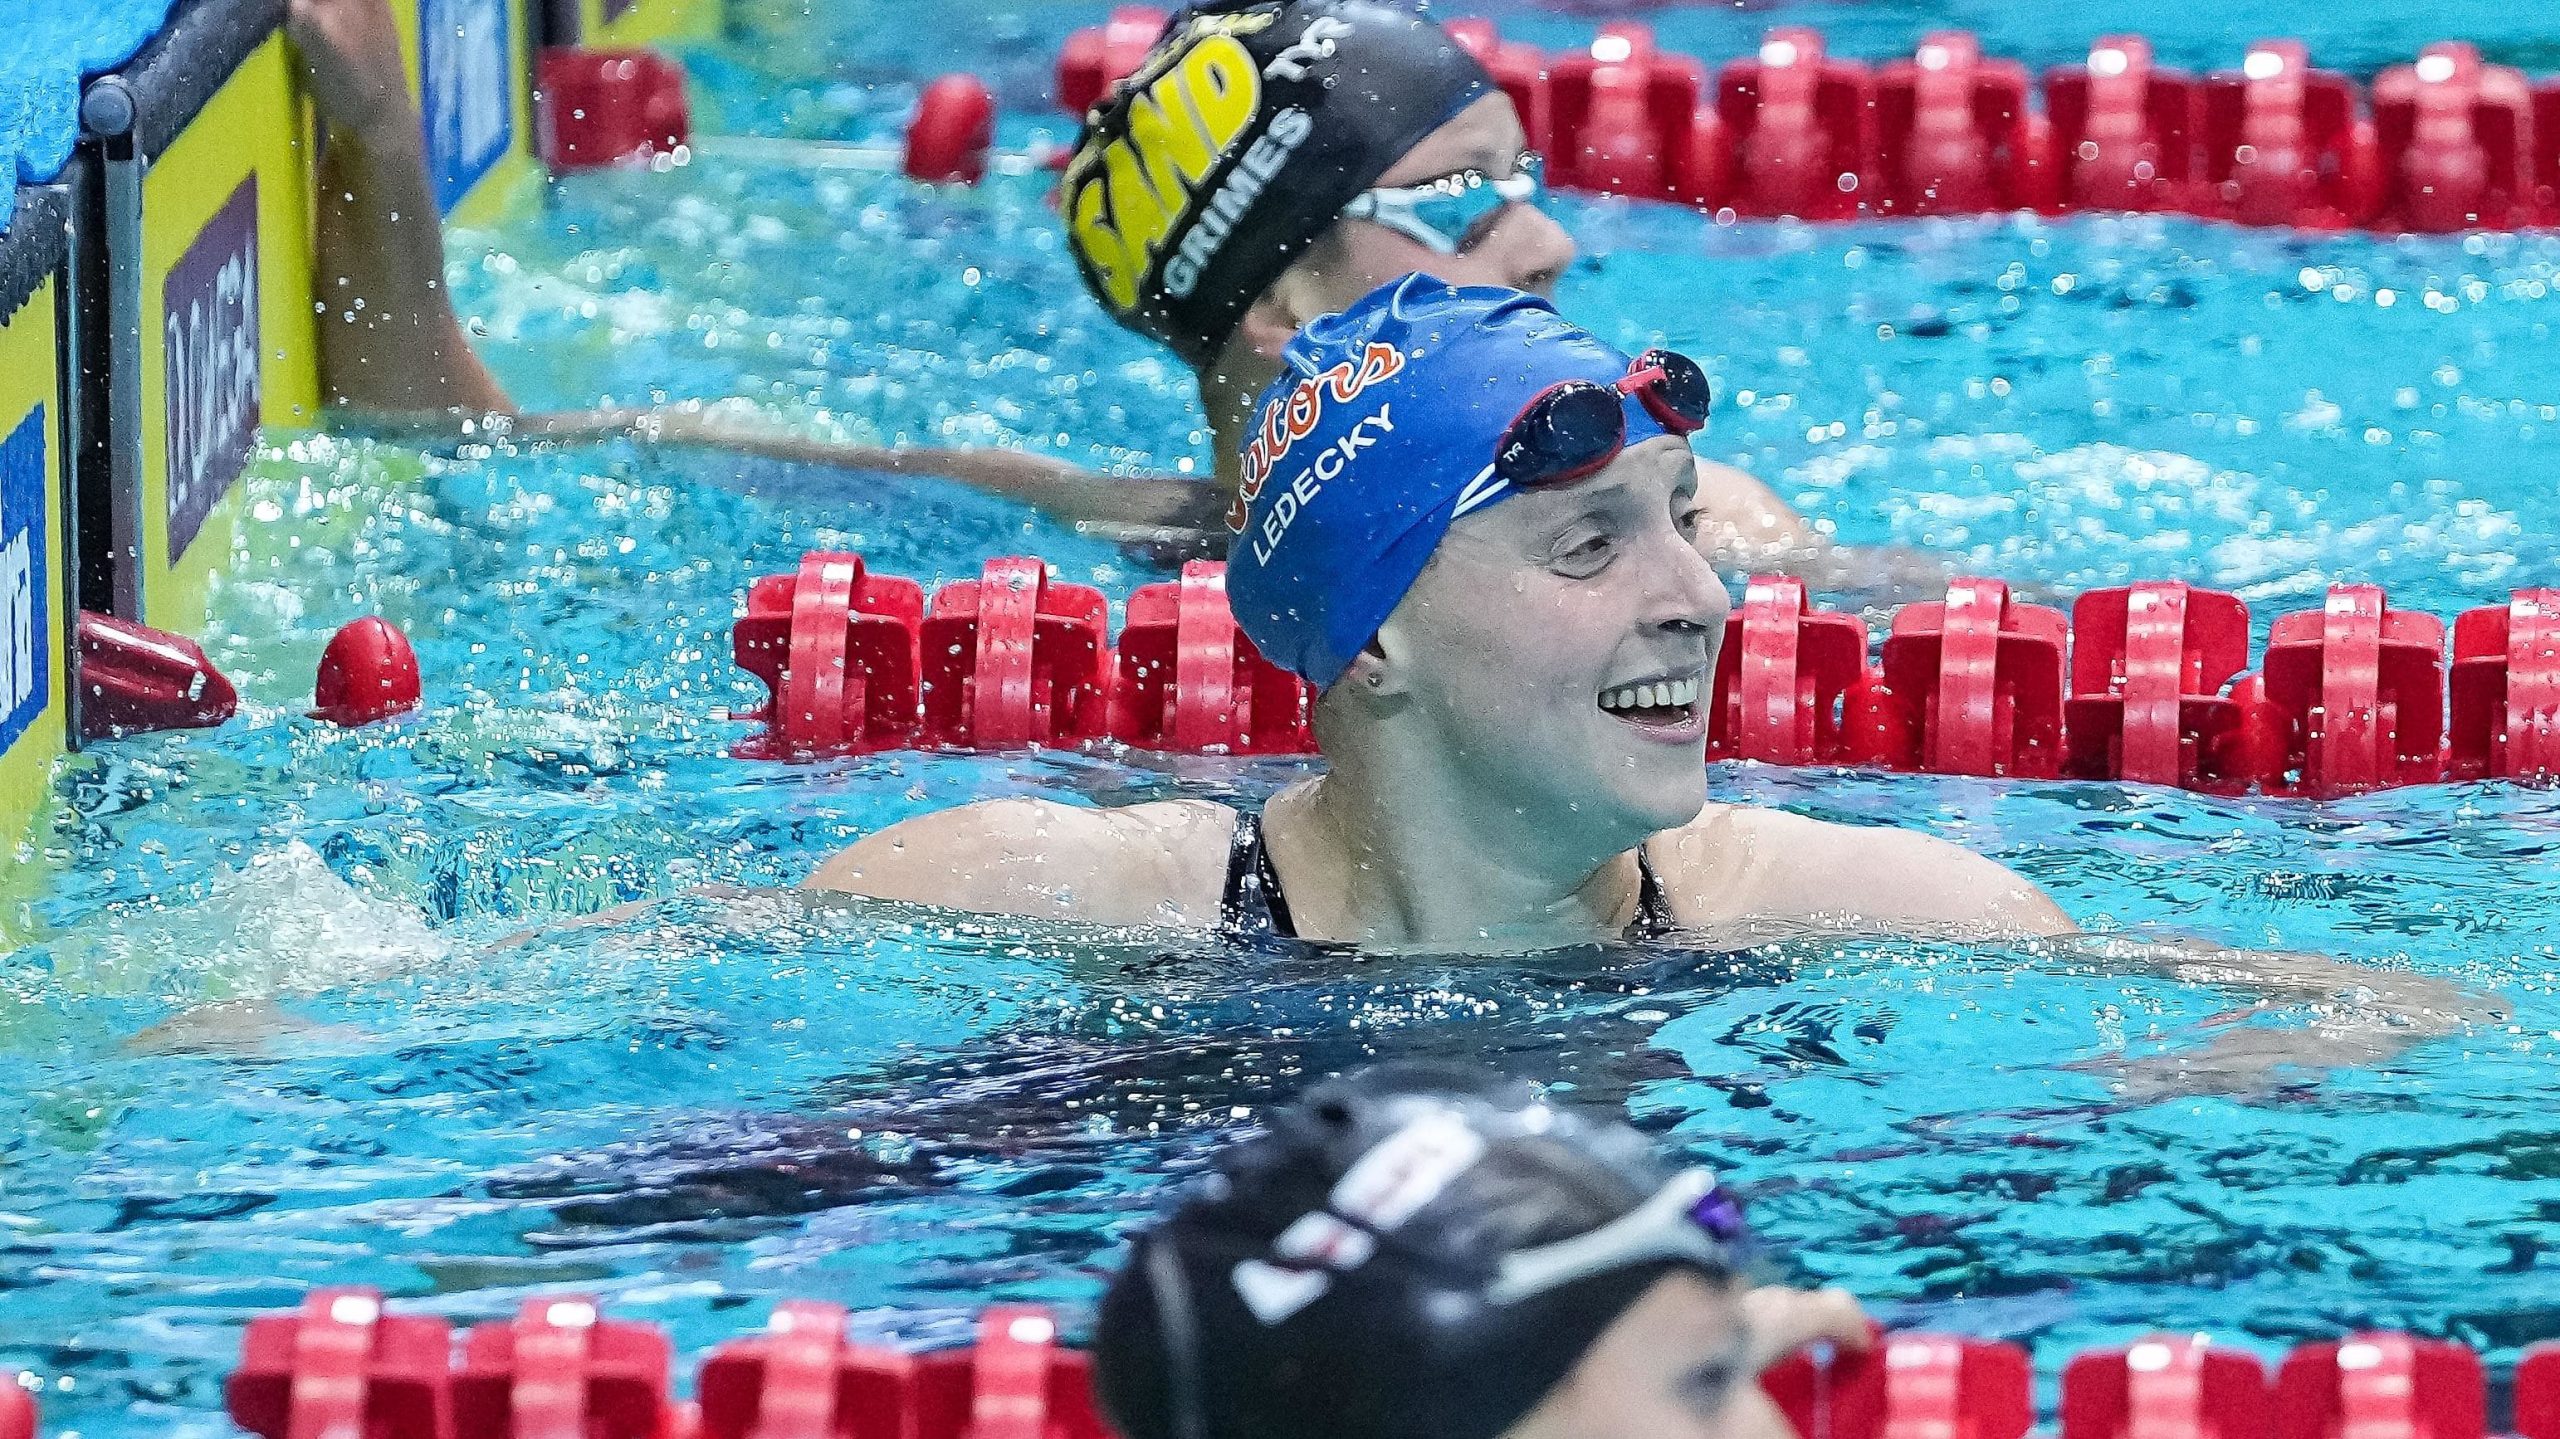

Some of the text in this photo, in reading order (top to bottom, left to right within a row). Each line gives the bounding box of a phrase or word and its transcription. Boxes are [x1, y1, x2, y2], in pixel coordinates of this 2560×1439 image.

[1074, 34, 1262, 310] SAND
[1162, 107, 1313, 299] GRIMES
[1252, 402, 1395, 567] LEDECKY
[1503, 442, 1525, 462] TYR
